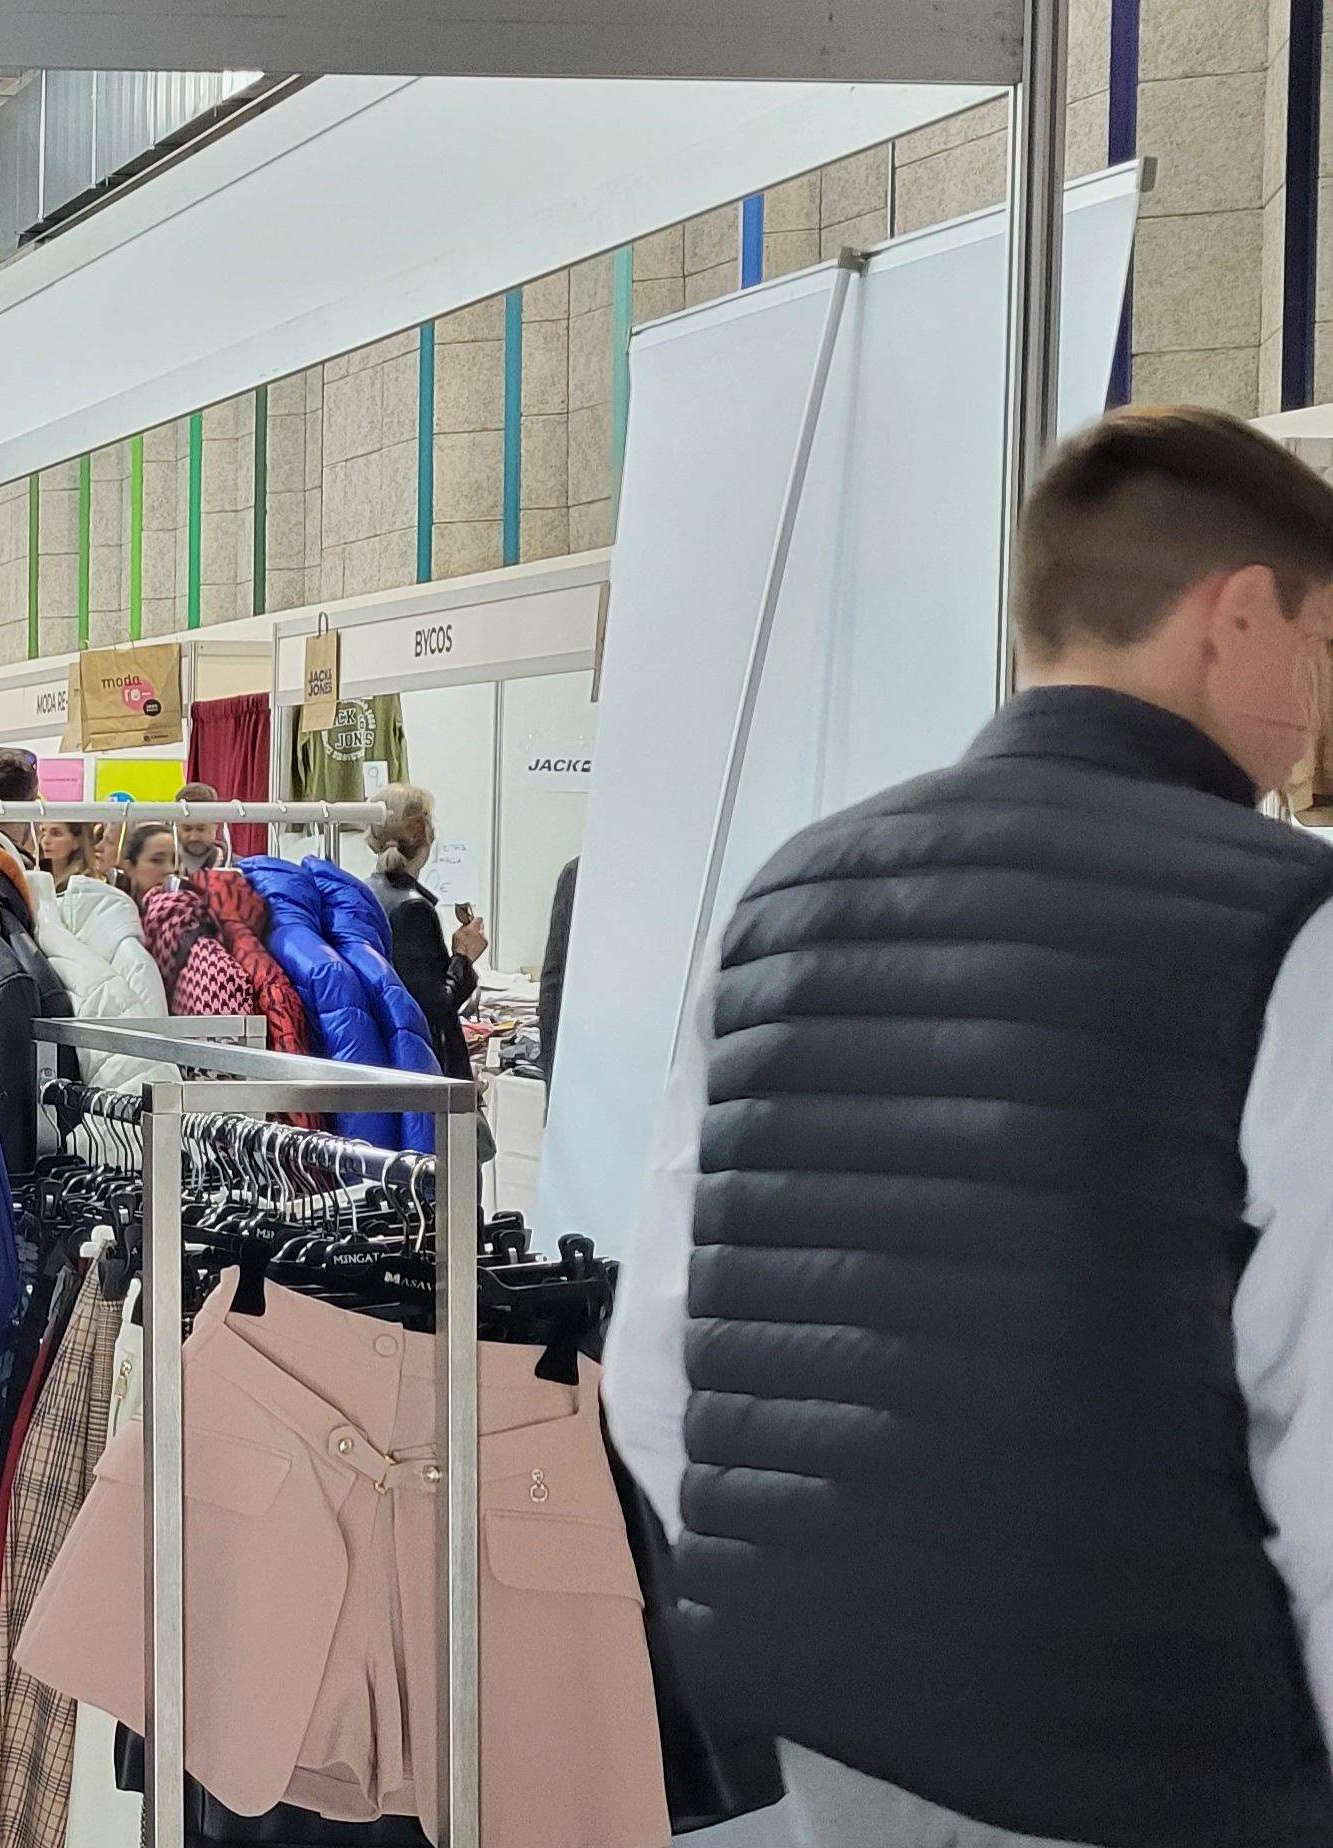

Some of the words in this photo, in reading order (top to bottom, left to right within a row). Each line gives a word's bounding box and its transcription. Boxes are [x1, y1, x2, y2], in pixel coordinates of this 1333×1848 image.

[414, 624, 453, 657] BYCOS
[101, 674, 142, 689] moda
[308, 683, 333, 697] JONES
[37, 692, 56, 714] MODA
[335, 730, 375, 750] JONS
[333, 1251, 383, 1265] MINGAT
